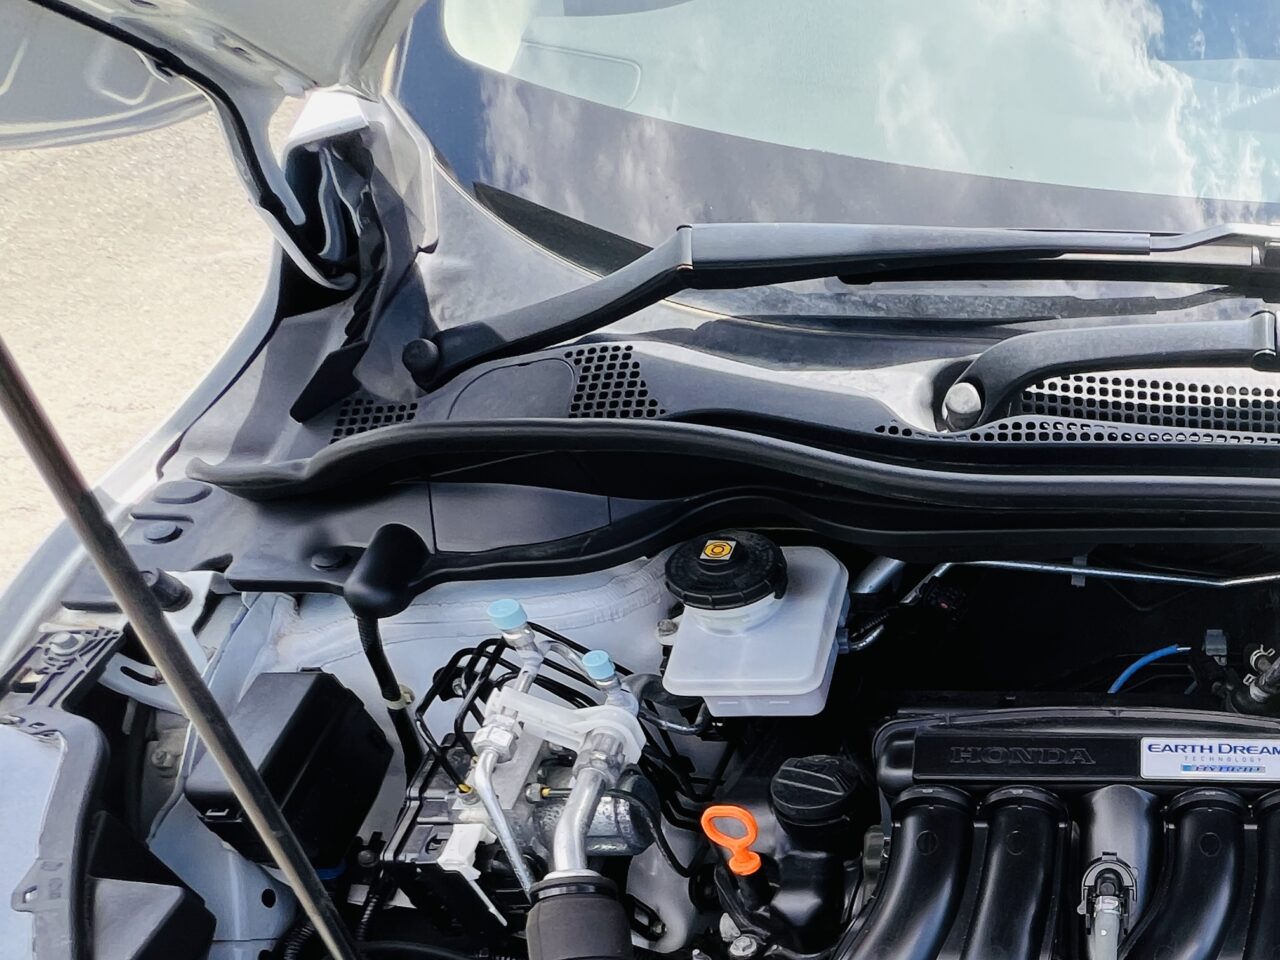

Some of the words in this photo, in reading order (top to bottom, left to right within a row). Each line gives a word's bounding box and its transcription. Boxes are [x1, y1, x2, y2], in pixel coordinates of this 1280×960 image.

[1148, 743, 1213, 754] EARTH
[950, 746, 1097, 765] HONDA
[1184, 755, 1262, 763] TECHNOLOGY
